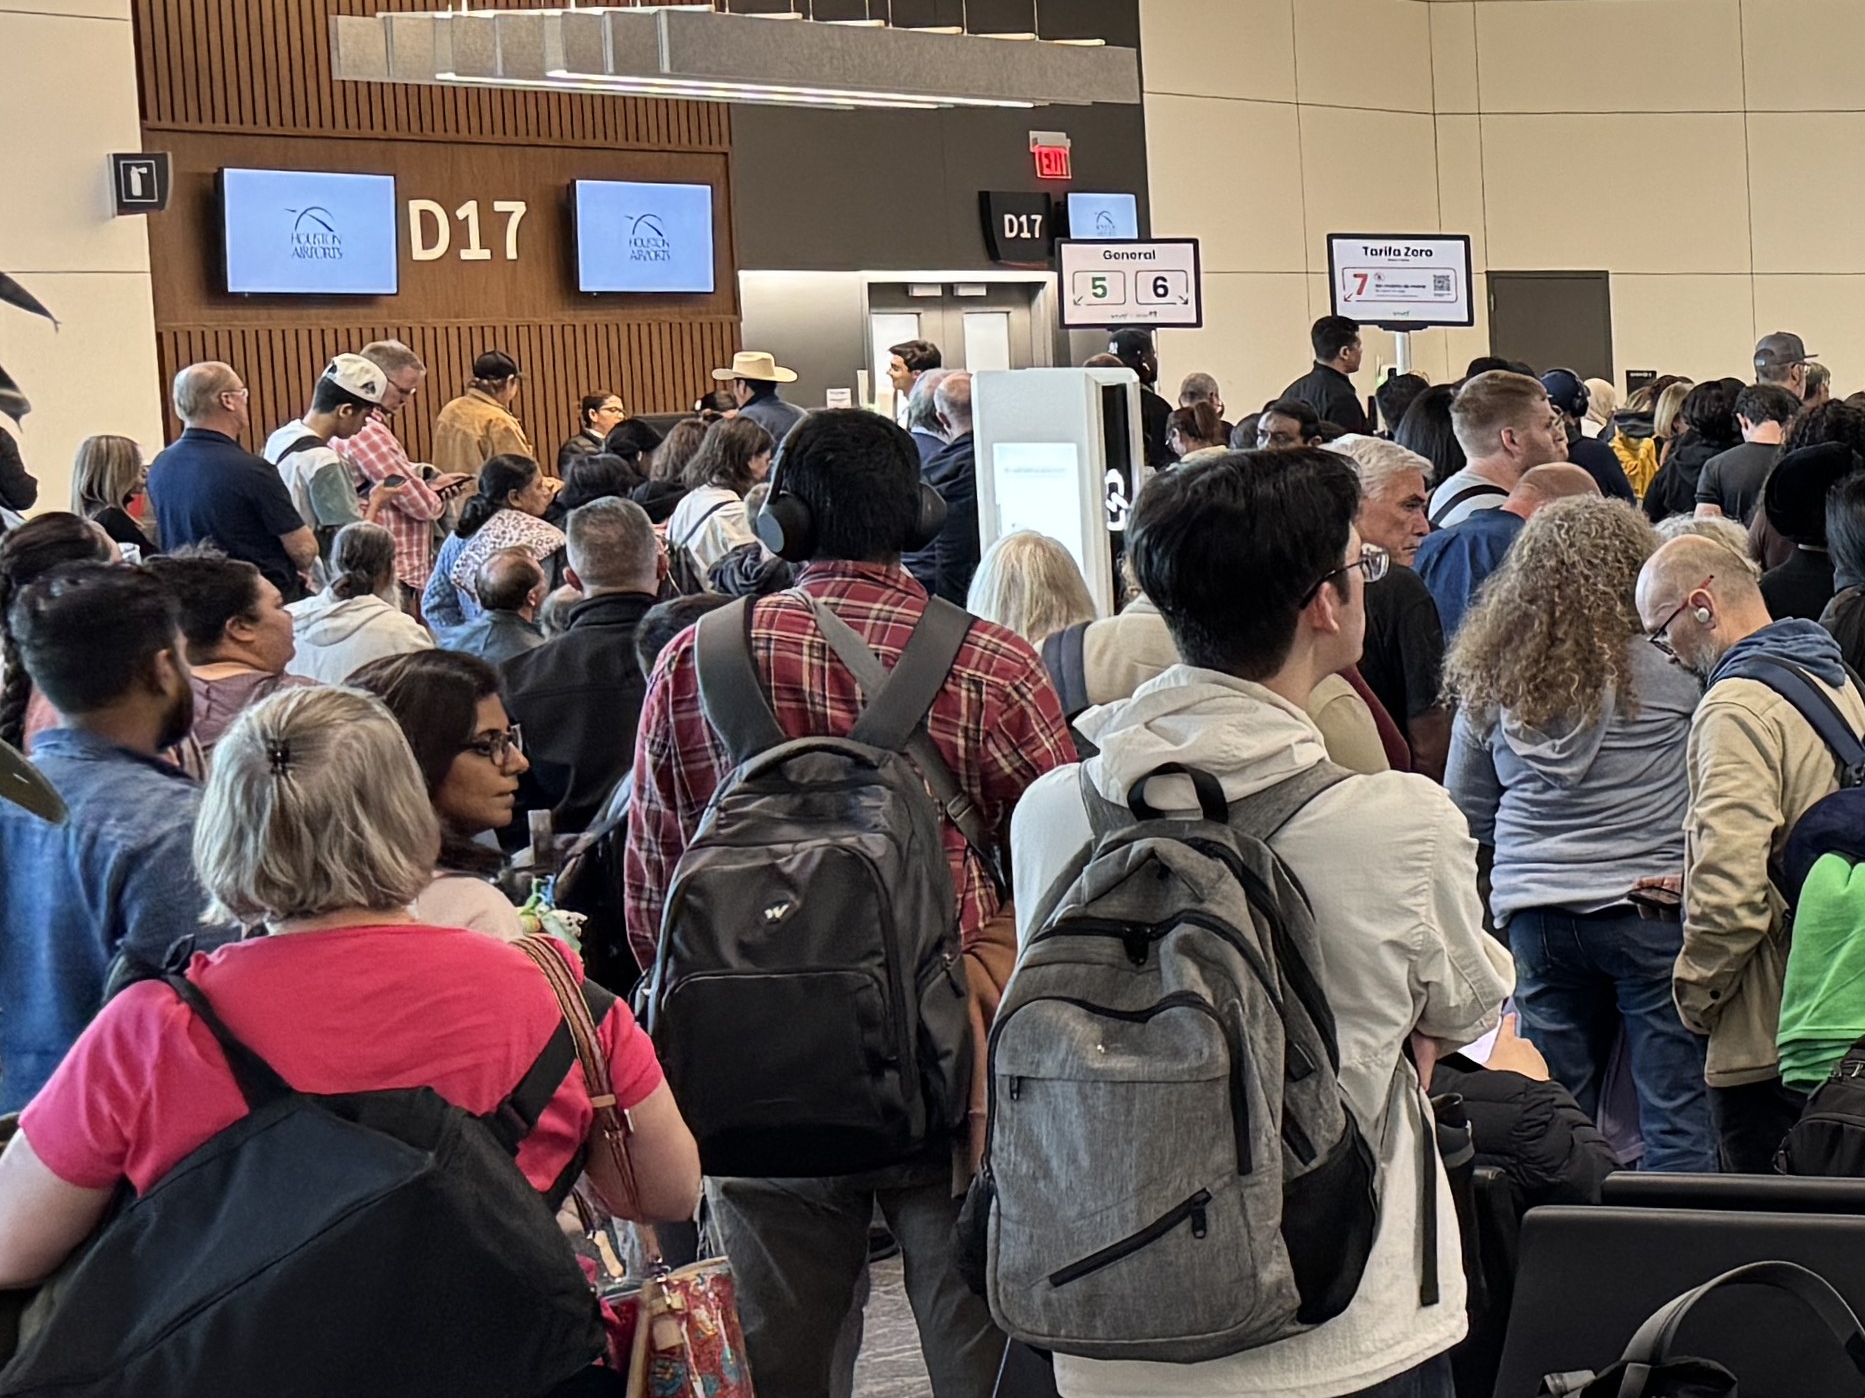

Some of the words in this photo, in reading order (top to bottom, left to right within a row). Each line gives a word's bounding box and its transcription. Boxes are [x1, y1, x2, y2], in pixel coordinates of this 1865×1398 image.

[408, 199, 527, 261] D17
[1003, 214, 1043, 239] D17
[1103, 249, 1156, 260] General
[1362, 246, 1401, 257] Tarifa
[1404, 247, 1433, 257] Zero
[1091, 276, 1108, 299] 5
[1152, 275, 1169, 298] 6
[1353, 273, 1368, 295] 7
